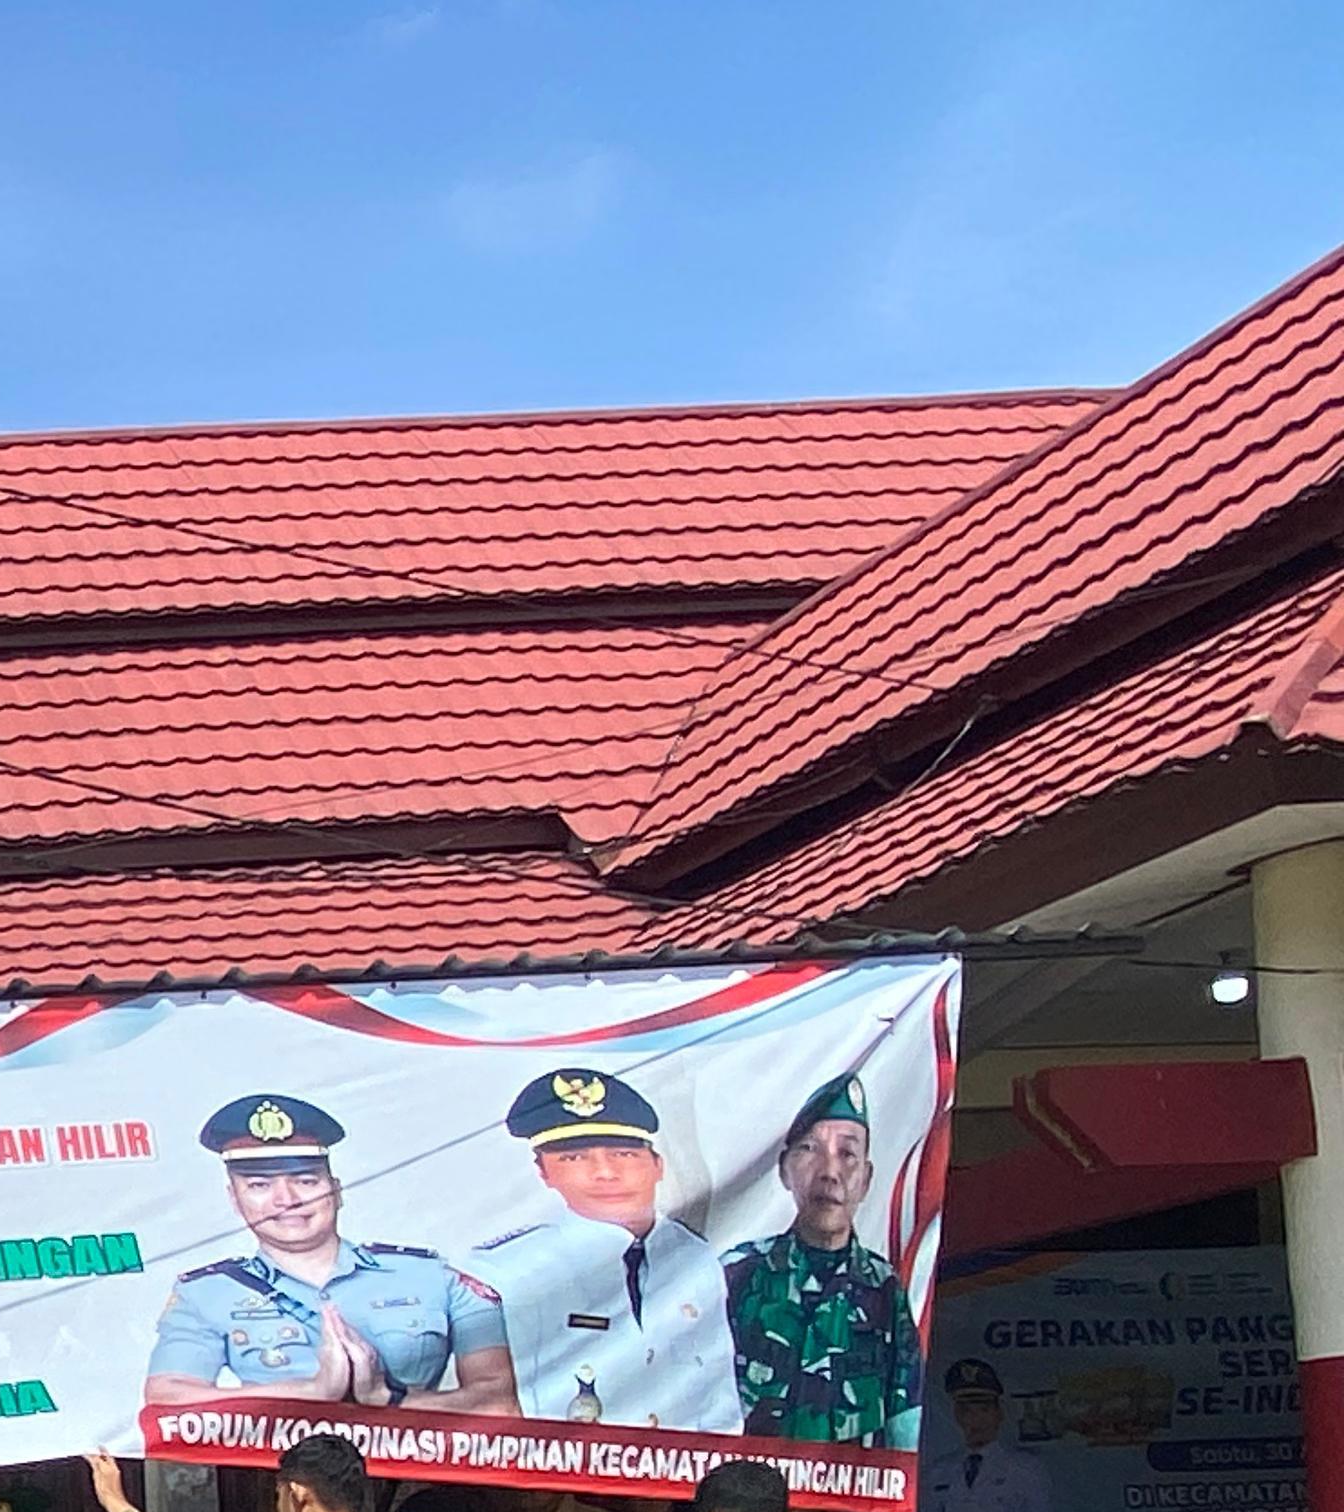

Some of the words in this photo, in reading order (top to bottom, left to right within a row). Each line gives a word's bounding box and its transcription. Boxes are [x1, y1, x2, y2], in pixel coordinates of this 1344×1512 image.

[57, 1122, 151, 1161] HILIR
[984, 1318, 1175, 1349] GERAKAN
[158, 1412, 267, 1449] FORUM
[450, 1431, 583, 1475] PIMPINAN
[588, 1441, 742, 1484] KECAMAT
[747, 1455, 850, 1495] TINGAN
[853, 1466, 906, 1501] HILIR
